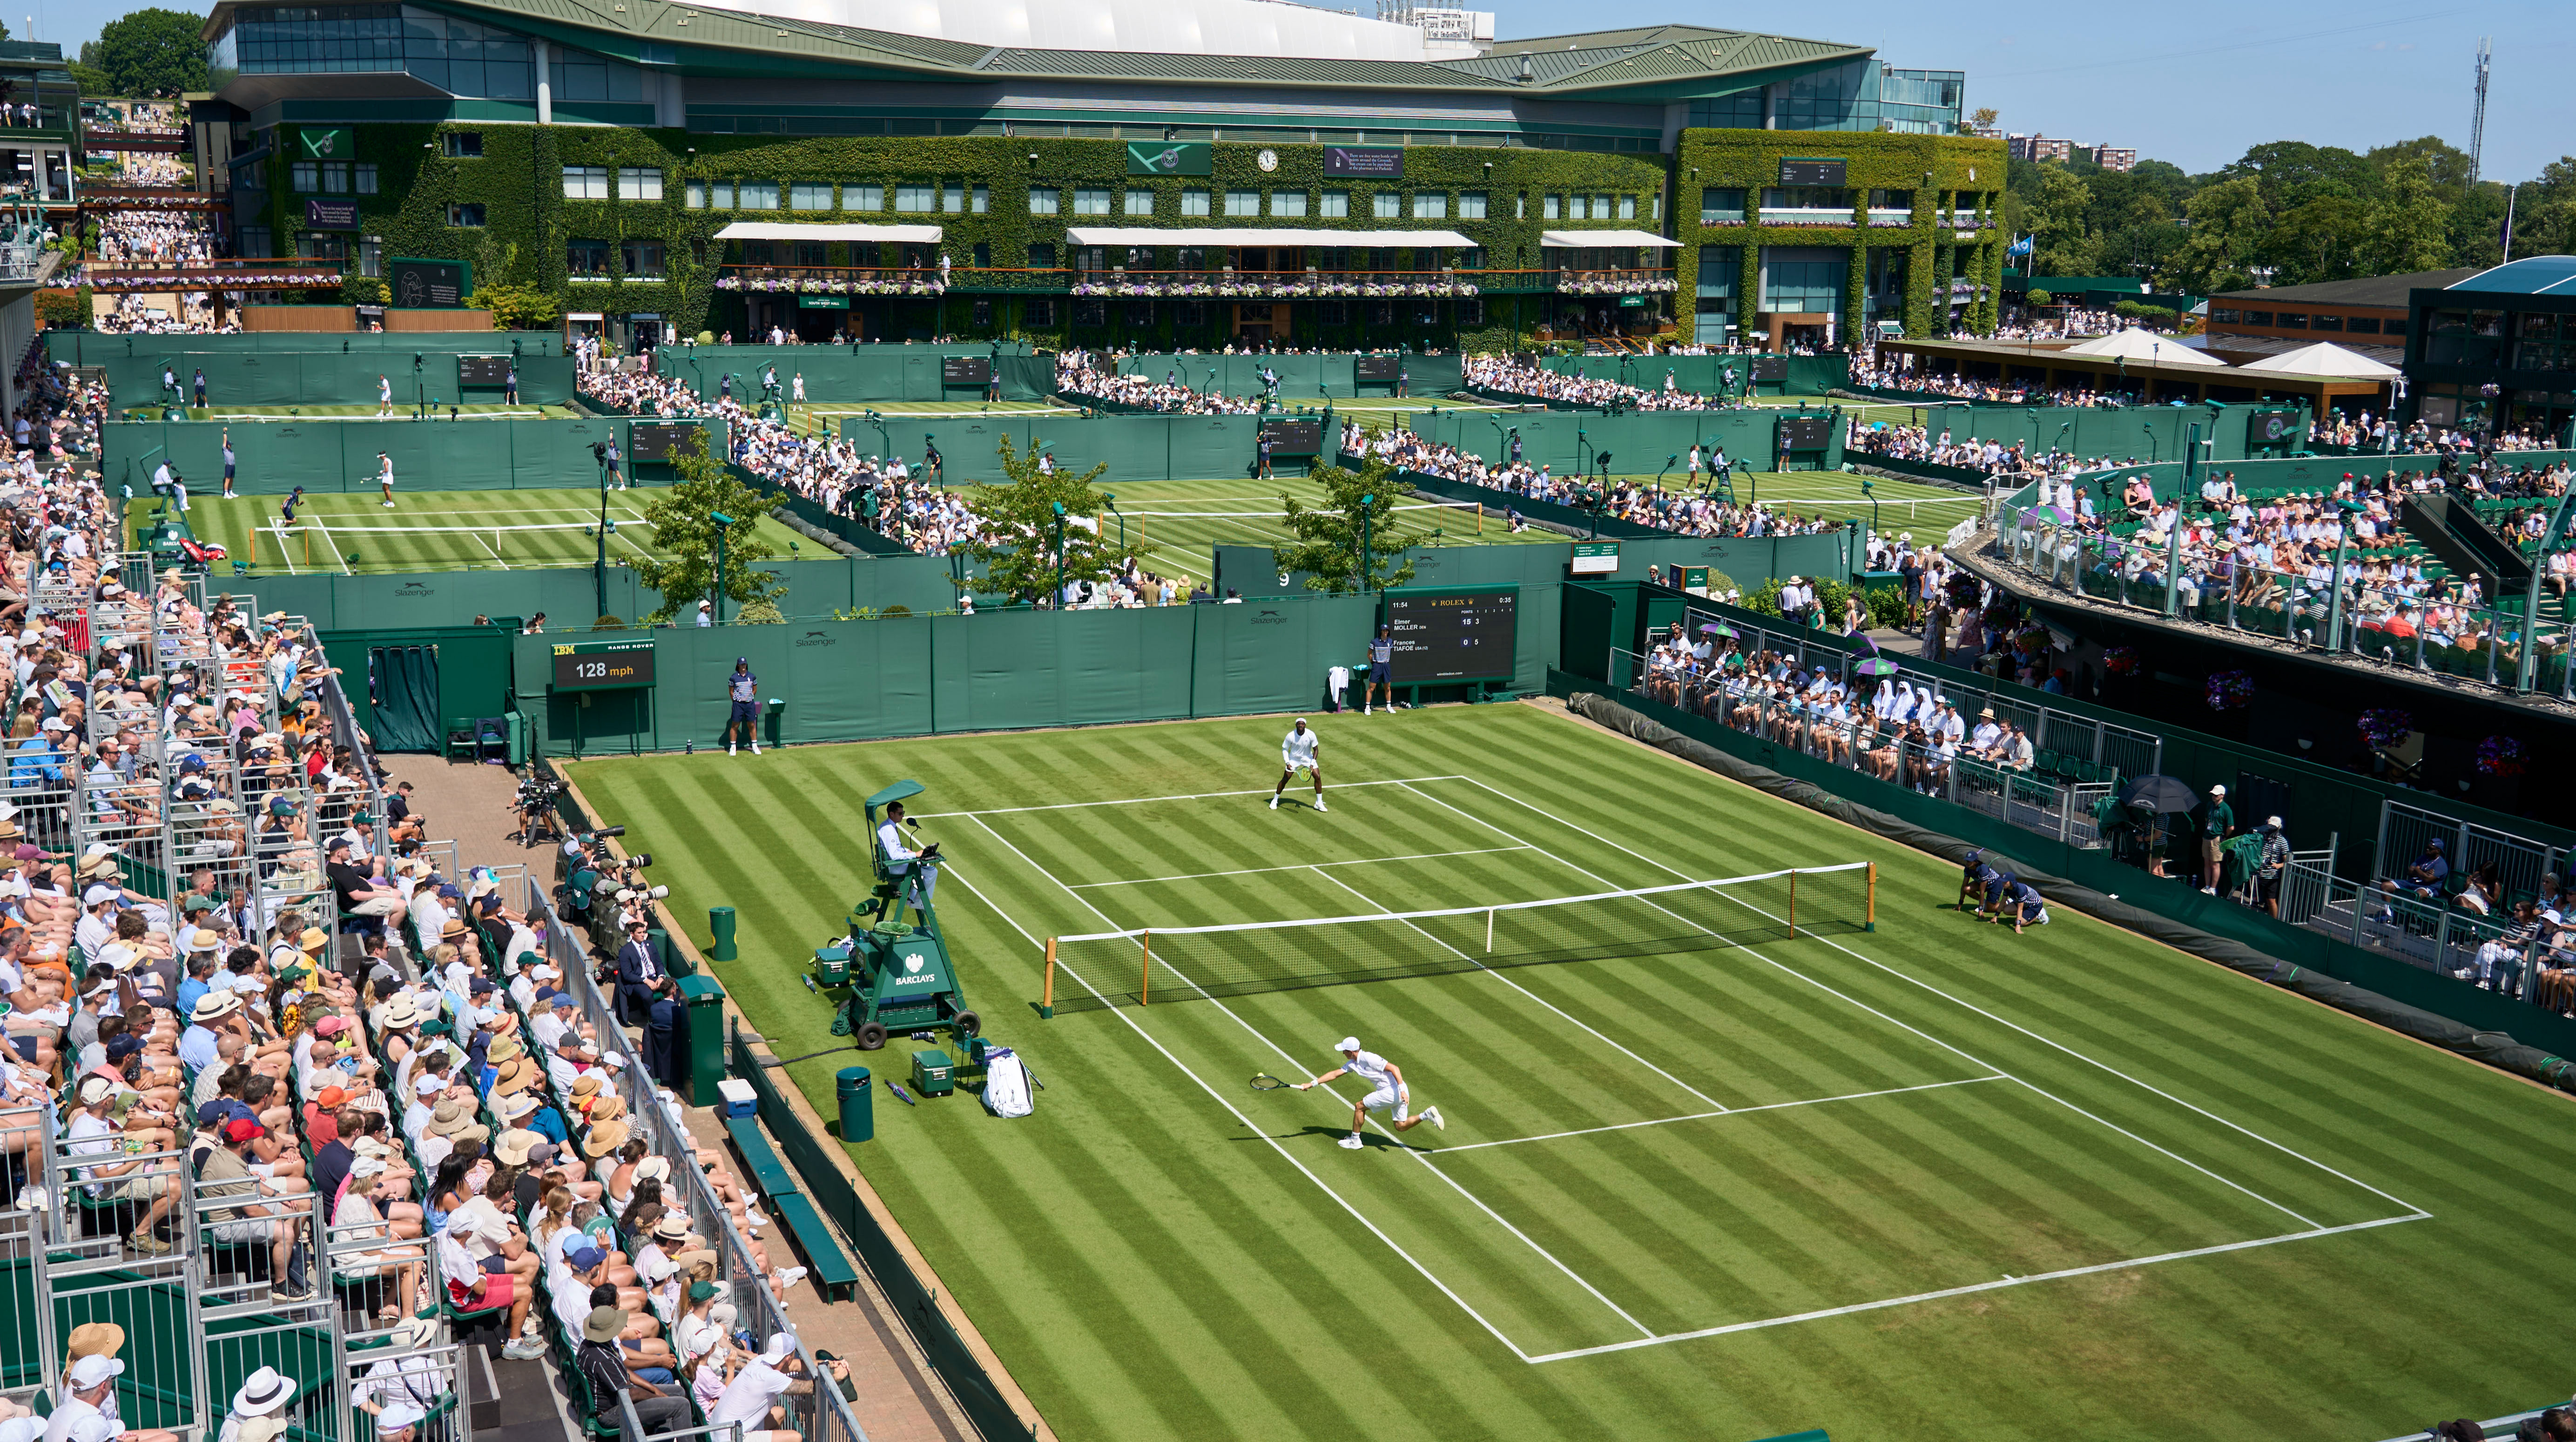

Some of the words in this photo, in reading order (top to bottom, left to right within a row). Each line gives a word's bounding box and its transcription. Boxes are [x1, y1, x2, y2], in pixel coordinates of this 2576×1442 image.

[1843, 551, 1847, 564] 9
[1279, 572, 1289, 587] 9
[796, 638, 836, 647] Slazenger
[554, 645, 574, 655] IBM
[577, 663, 606, 677] 128
[610, 666, 633, 677] mph
[896, 974, 935, 985] BARCLAYS
